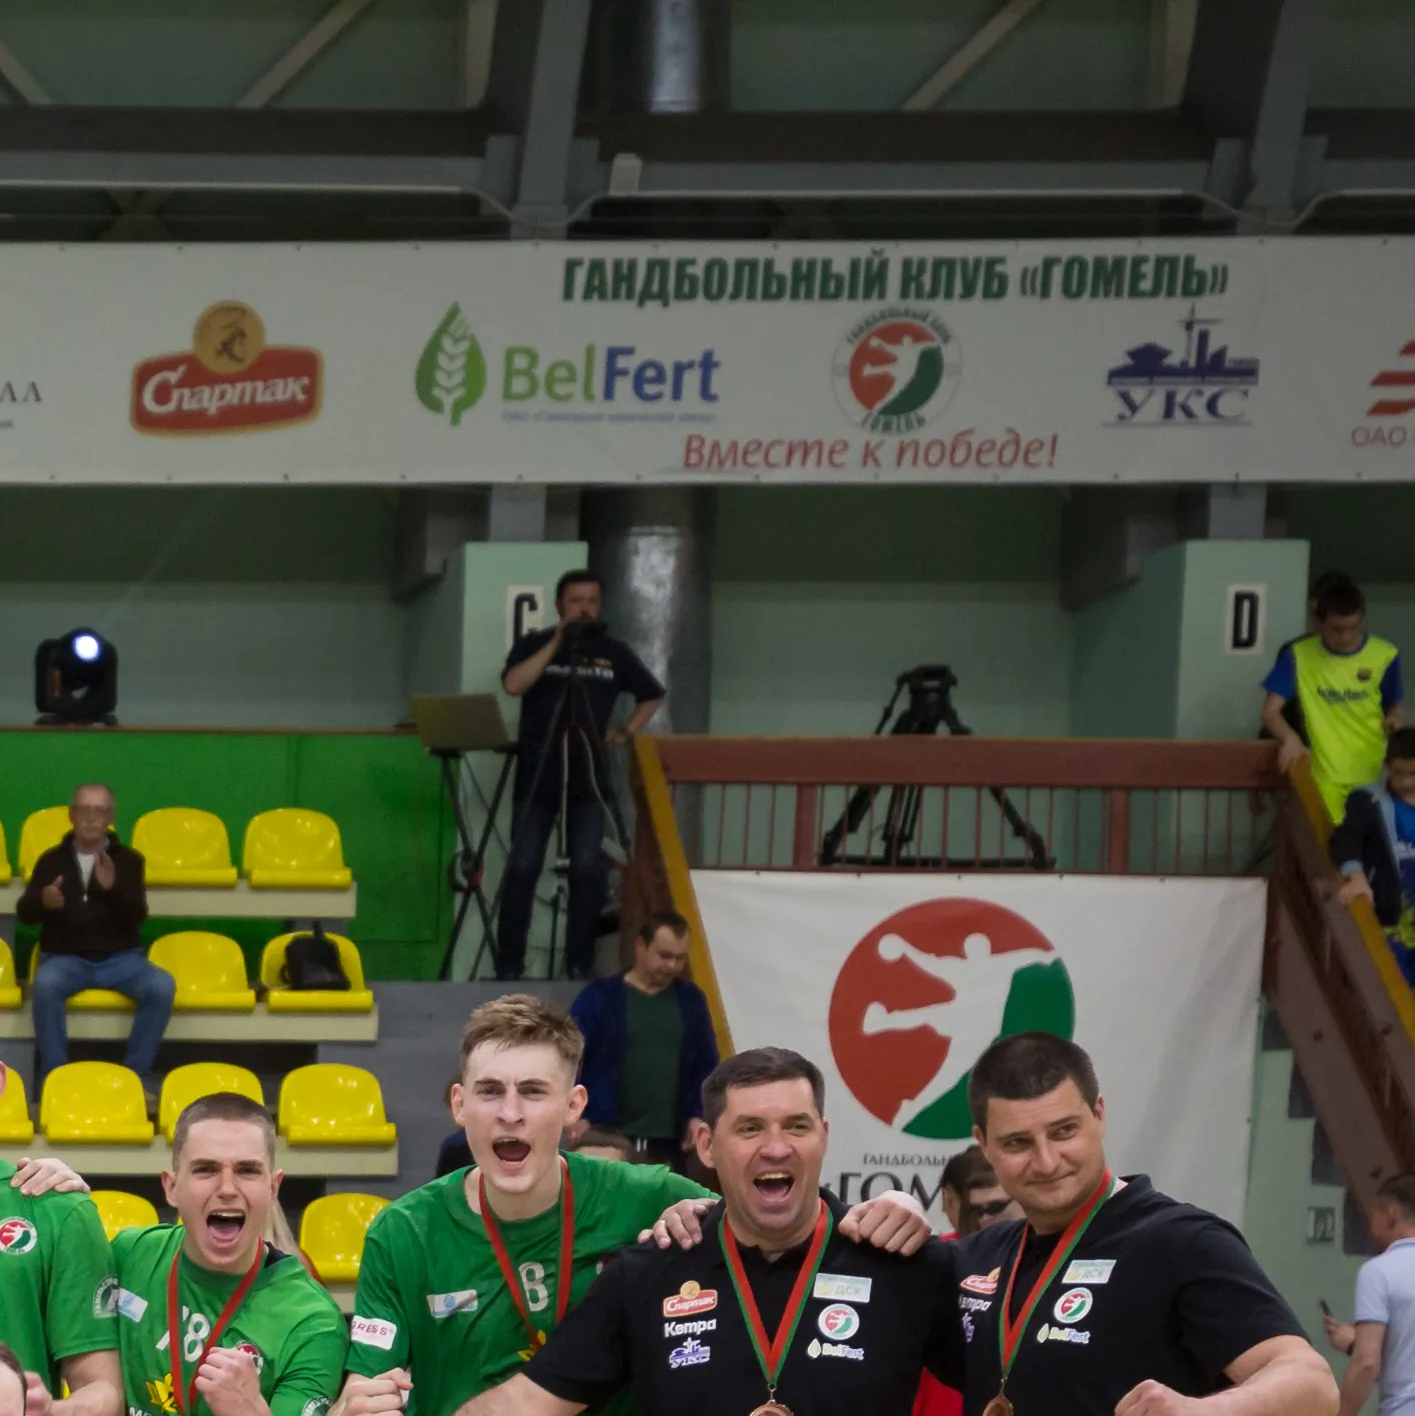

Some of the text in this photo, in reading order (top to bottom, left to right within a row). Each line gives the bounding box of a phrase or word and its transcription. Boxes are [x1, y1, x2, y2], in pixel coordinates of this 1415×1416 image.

[561, 249, 1228, 308] ГАНДБОЛЬНЫЙ КЛУБ «ГОМЕЛЬ»
[141, 364, 311, 419] Спартак
[502, 342, 721, 403] BelFert
[1116, 386, 1251, 424] УКС
[683, 434, 849, 470] Вместе
[895, 427, 1059, 470] победе!
[1233, 591, 1260, 649] D
[664, 1319, 717, 1338] Kempa
